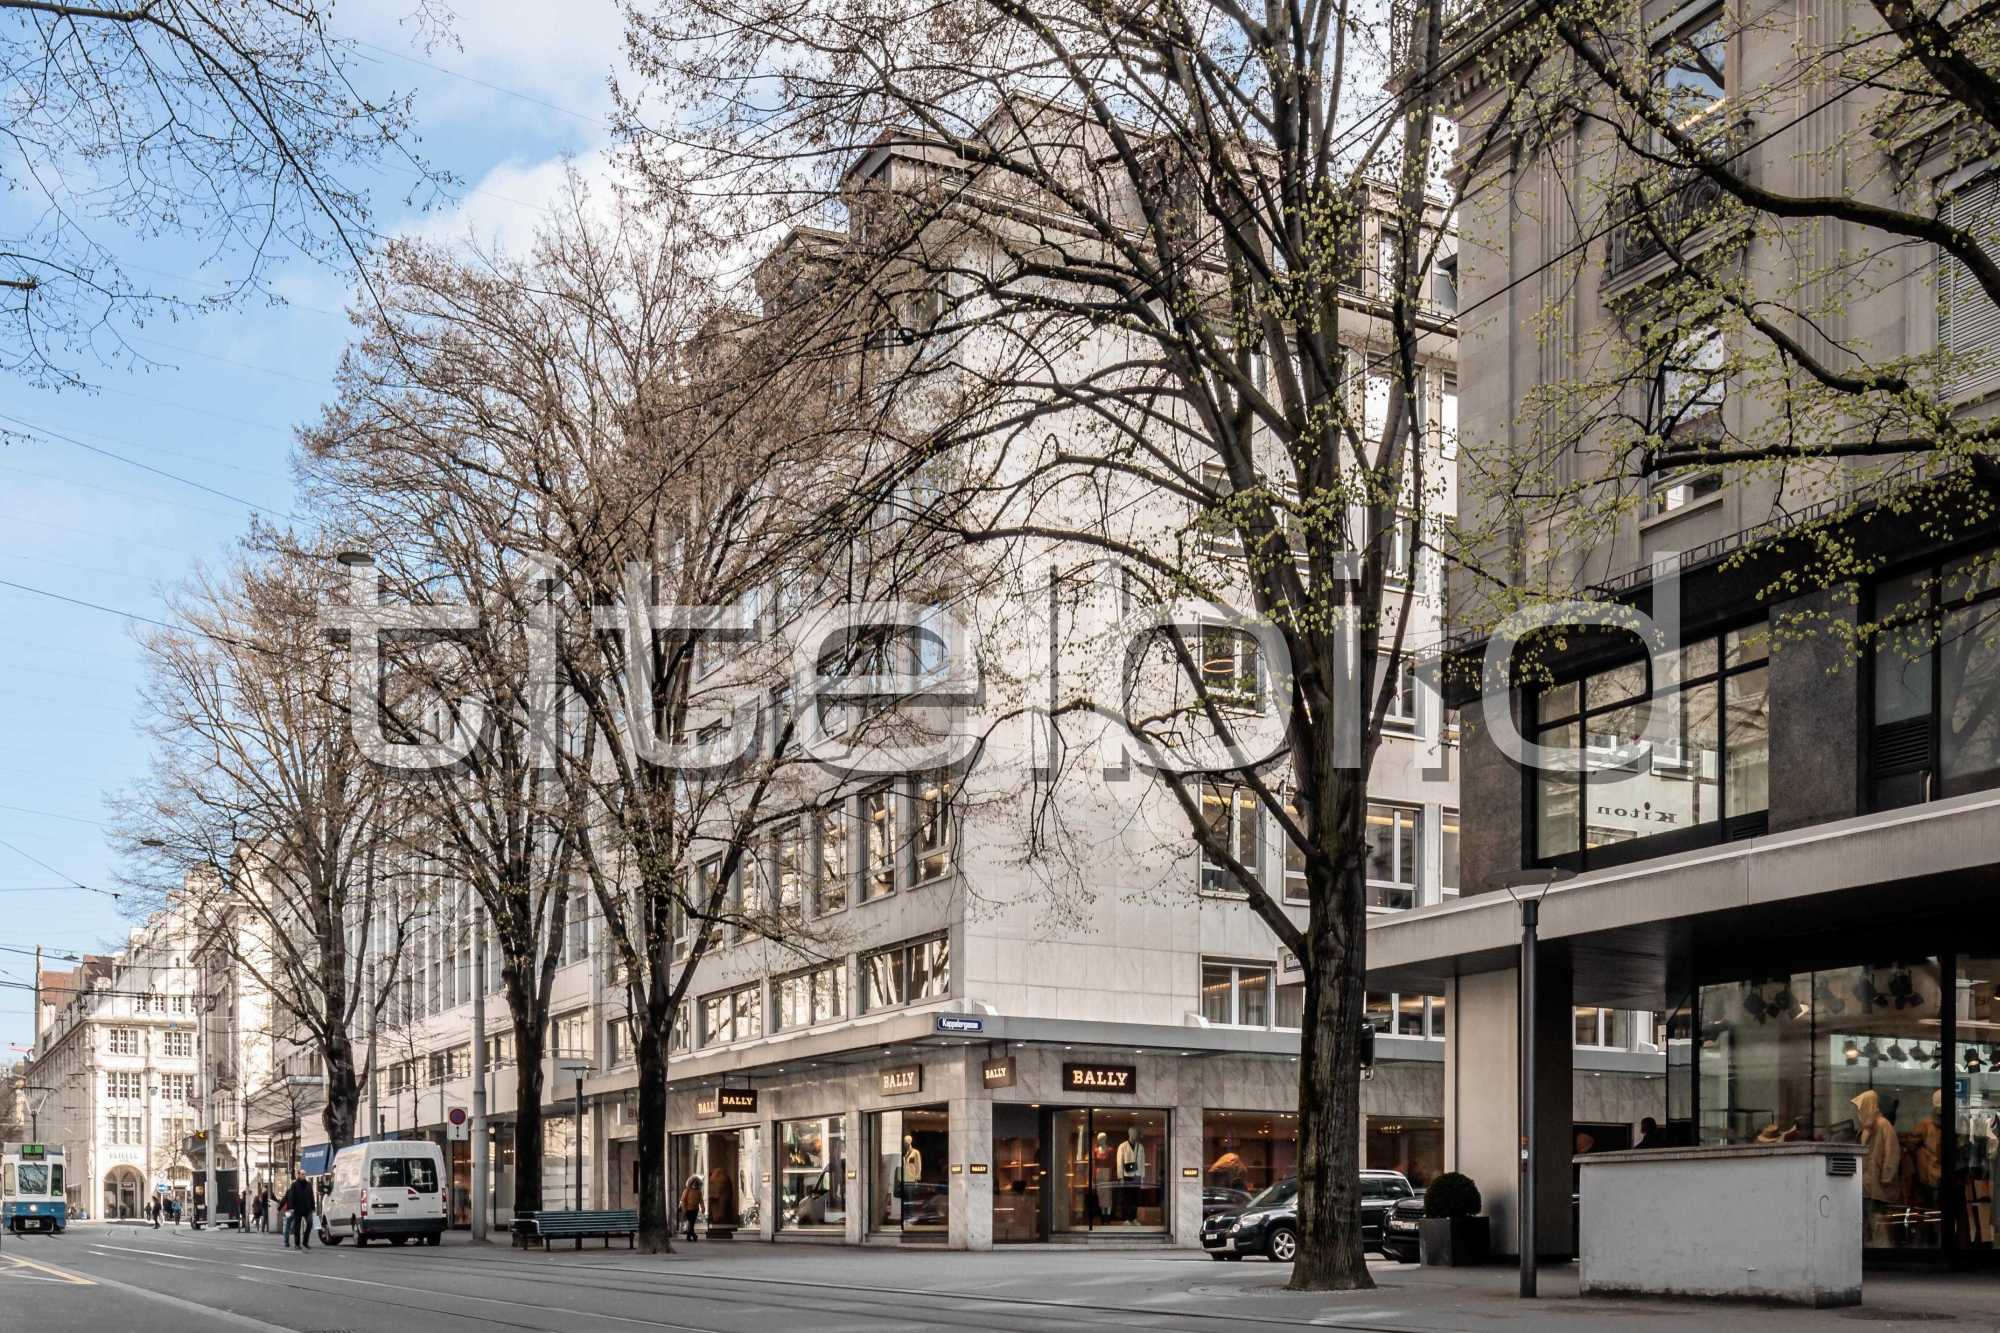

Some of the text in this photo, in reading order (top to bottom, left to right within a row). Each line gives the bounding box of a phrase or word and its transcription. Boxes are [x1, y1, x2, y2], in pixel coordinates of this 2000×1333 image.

[985, 1067, 1007, 1079] BALLY
[1072, 1070, 1128, 1086] BALLY
[883, 1072, 915, 1089] BALLY
[722, 1096, 753, 1105] BALLY
